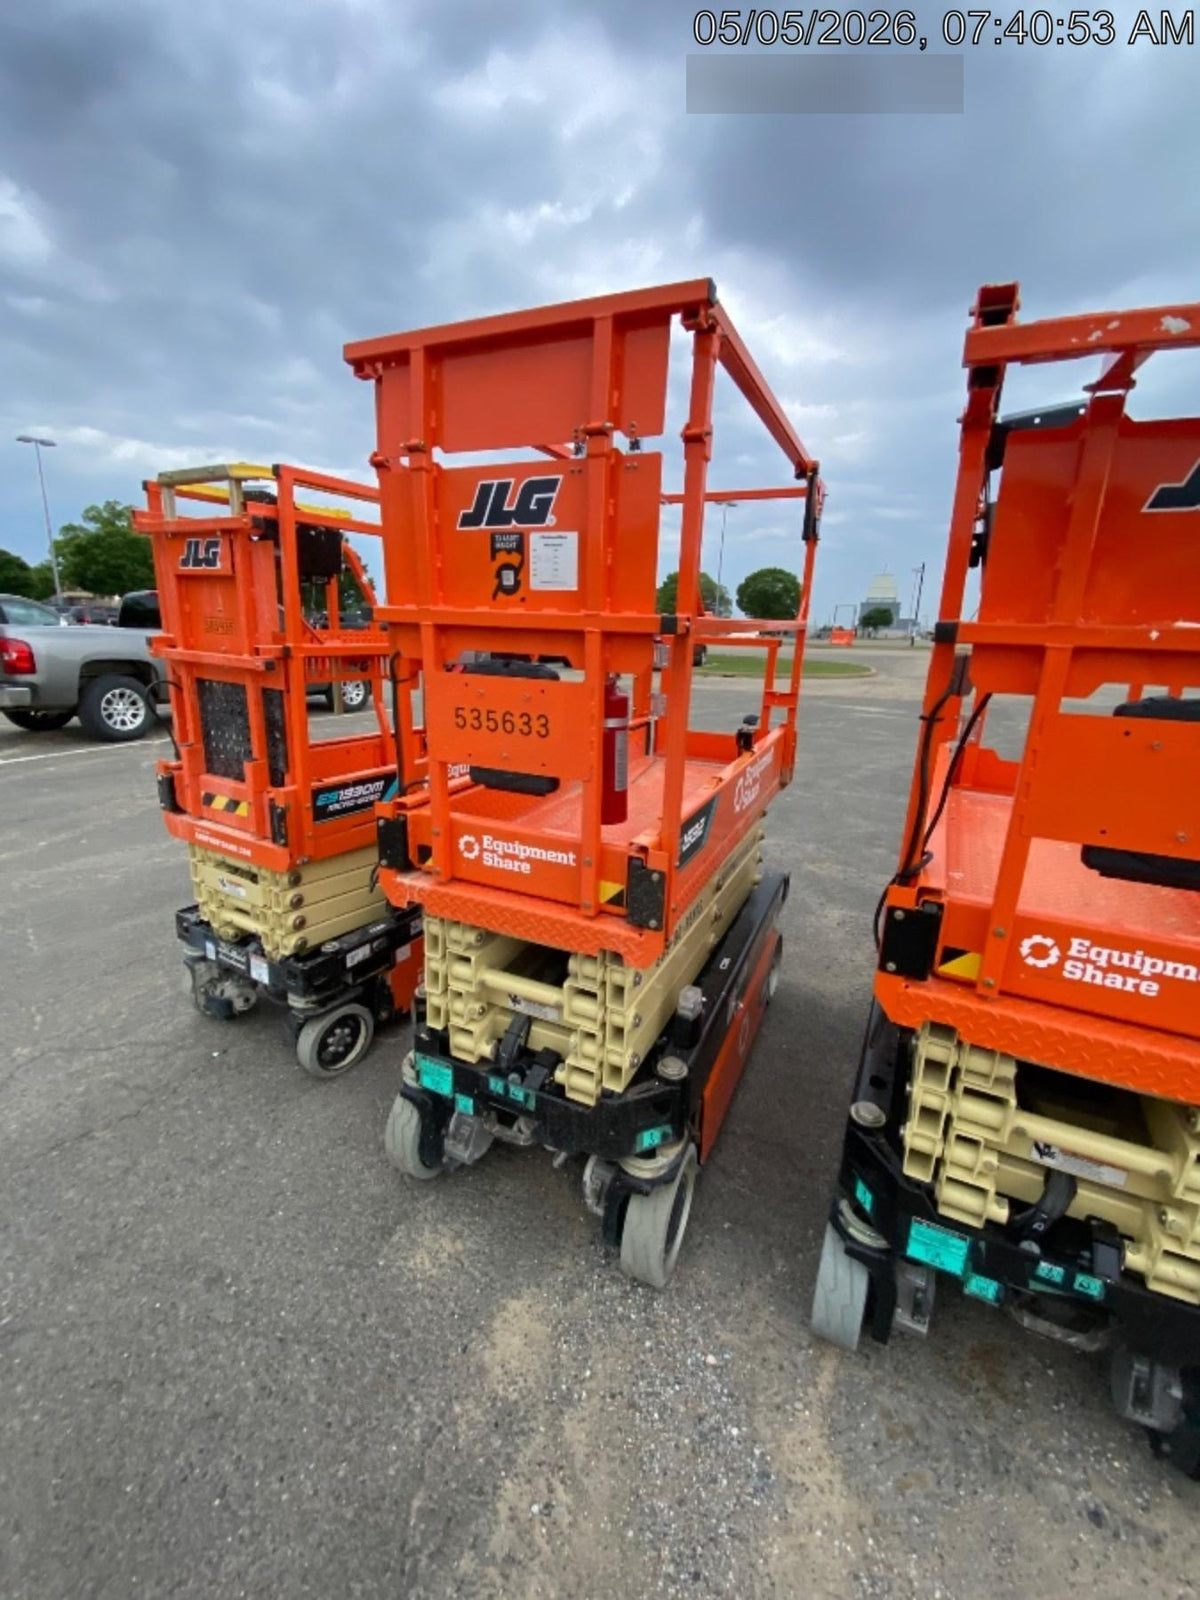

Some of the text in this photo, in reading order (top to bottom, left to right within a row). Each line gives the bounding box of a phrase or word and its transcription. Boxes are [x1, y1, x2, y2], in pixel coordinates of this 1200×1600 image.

[456, 475, 563, 530] JLG
[180, 538, 222, 570] JLG
[455, 707, 550, 738] 535633
[482, 835, 577, 867] Equipment
[482, 852, 531, 874] Share
[1062, 961, 1160, 997] Share
